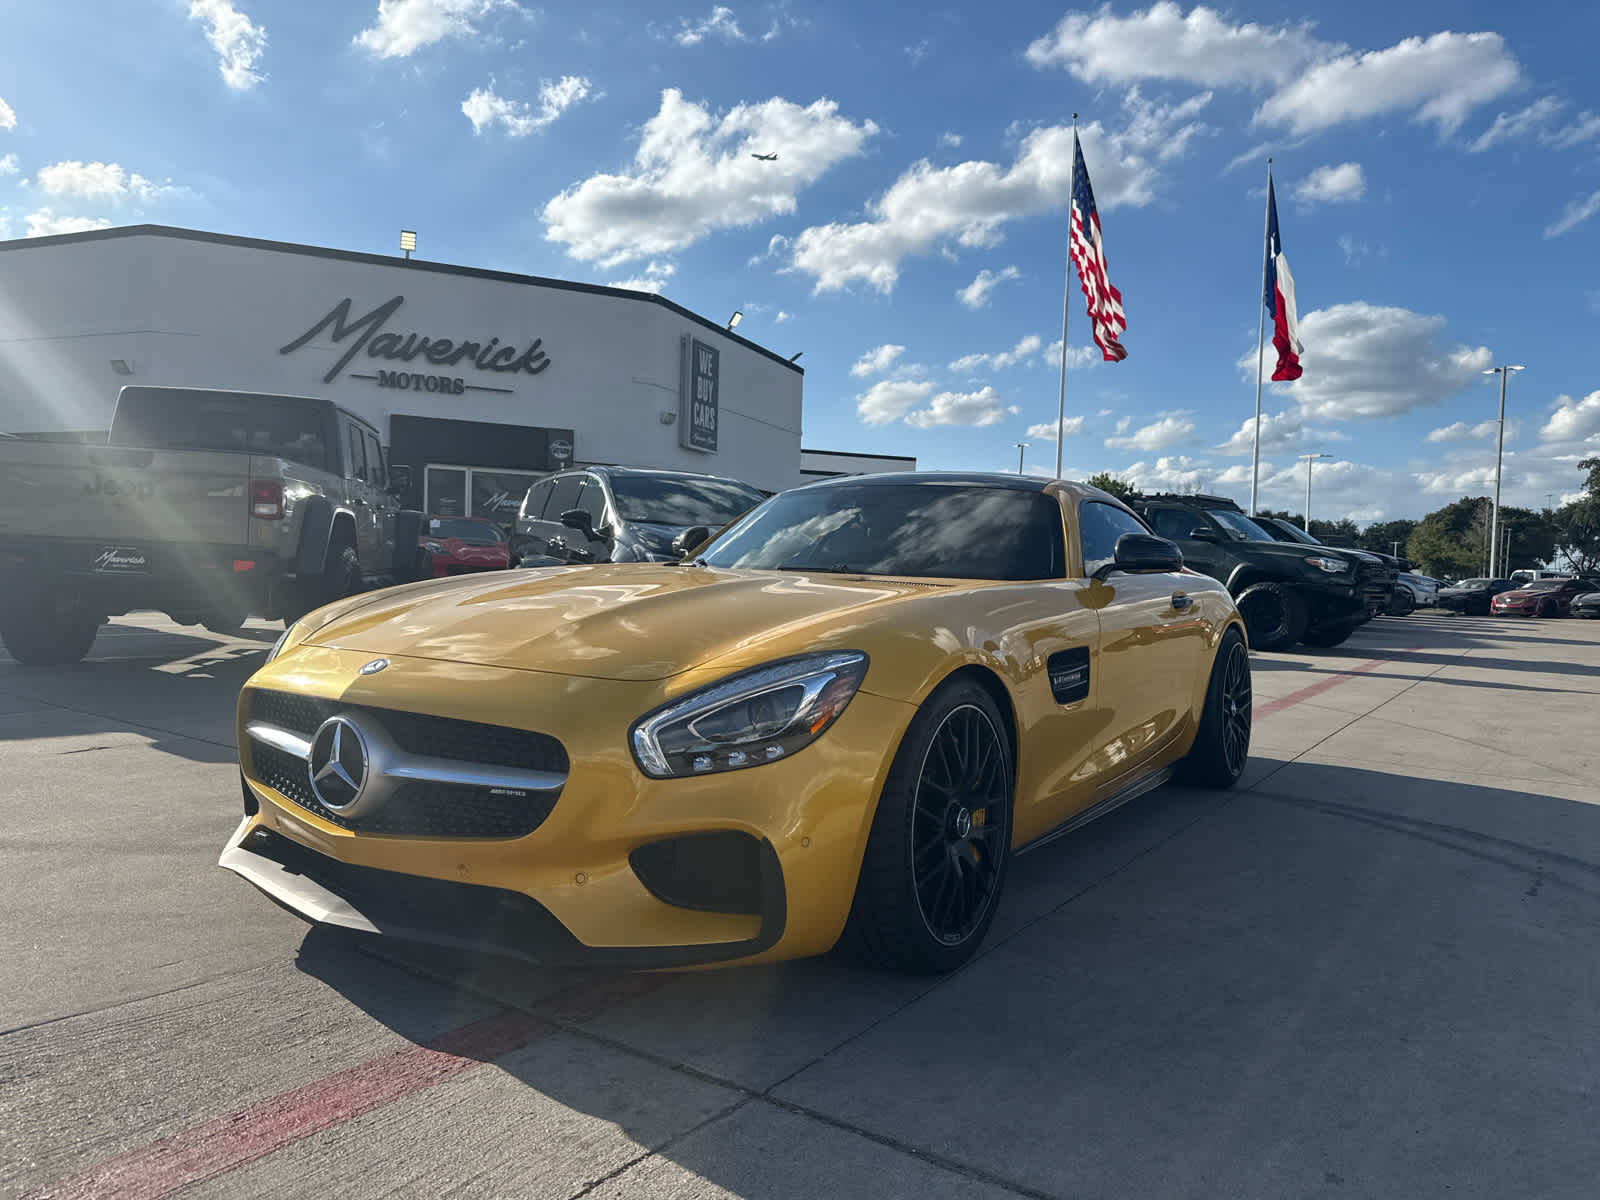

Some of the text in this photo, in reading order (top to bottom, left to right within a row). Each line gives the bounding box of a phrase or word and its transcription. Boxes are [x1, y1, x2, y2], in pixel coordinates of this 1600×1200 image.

[280, 295, 551, 384] Maverick
[698, 349, 713, 376] WE
[377, 370, 465, 394] MOTORS
[697, 376, 714, 403] BUY
[694, 402, 715, 430] CARS
